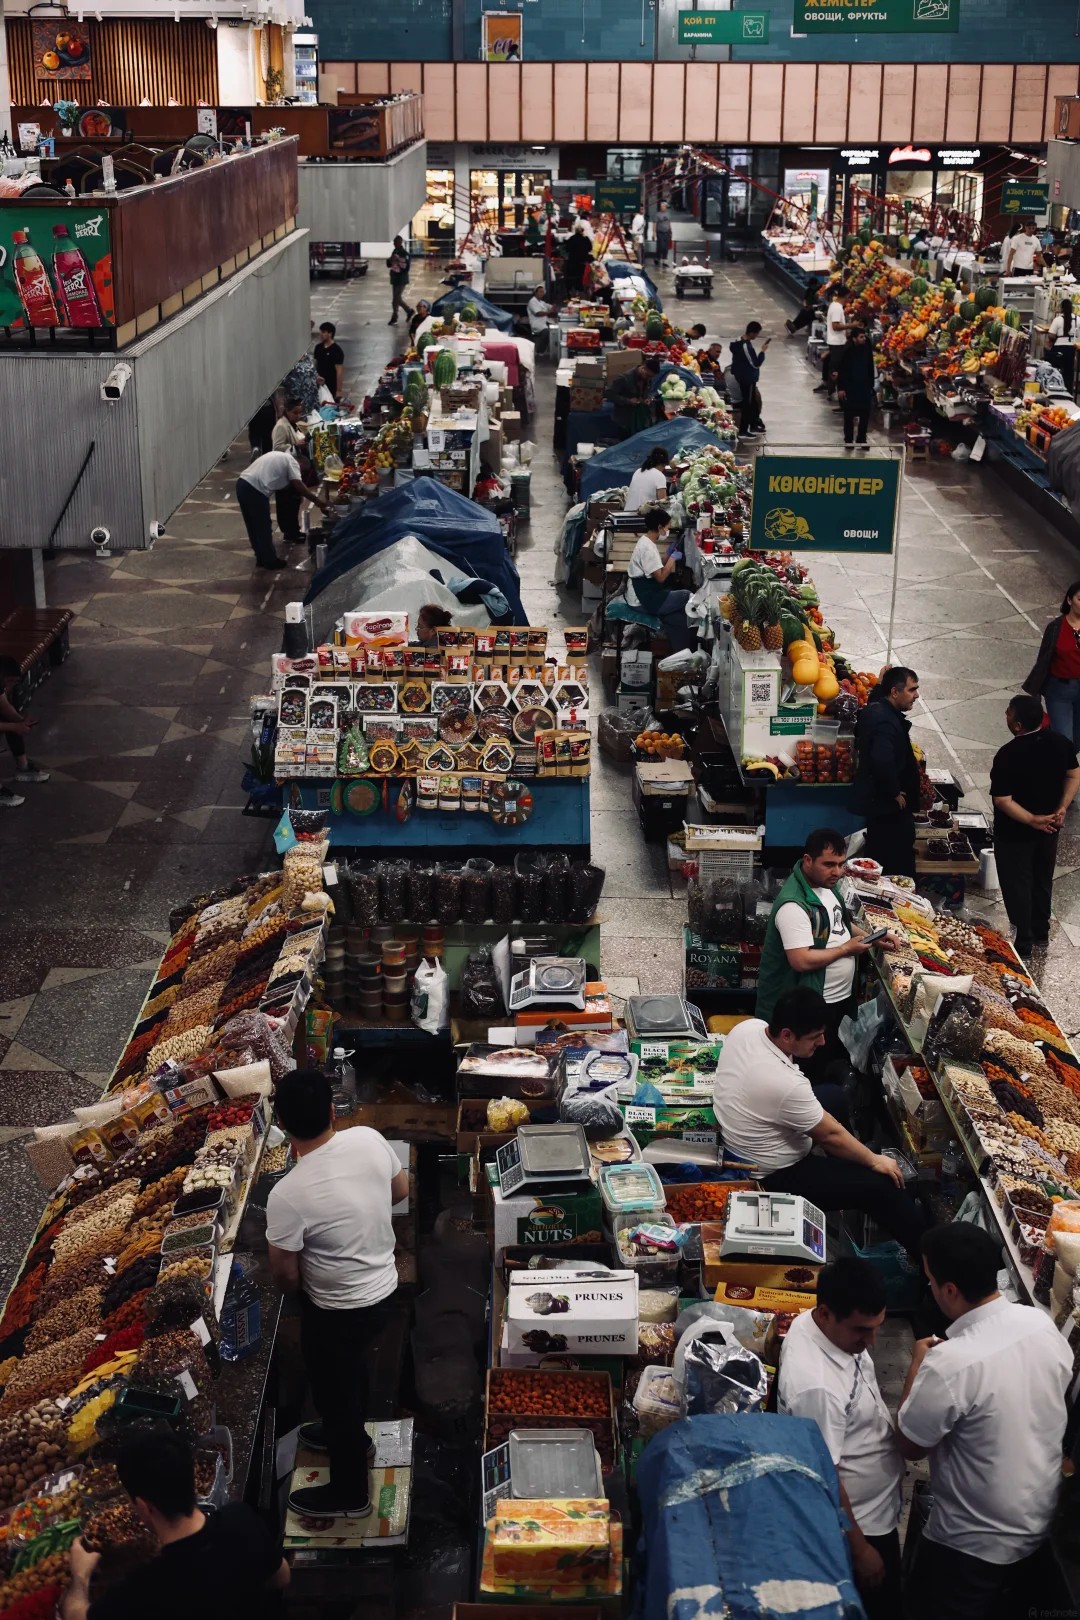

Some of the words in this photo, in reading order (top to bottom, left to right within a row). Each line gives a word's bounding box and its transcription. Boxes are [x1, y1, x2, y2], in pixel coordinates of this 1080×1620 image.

[684, 16, 703, 26] ҚОЙ
[704, 17, 716, 25] ЕТІ
[804, 12, 844, 22] ОВОЩИ,
[847, 12, 887, 21] ФРУКТЫ
[768, 475, 884, 495] КӨКӨНІСТЕР
[843, 529, 879, 539] ОВОЩИ
[690, 953, 737, 964] ROYANA
[523, 1228, 573, 1243] NUTS
[575, 1293, 623, 1301] PRUNES
[578, 1334, 626, 1343] PRUNES
